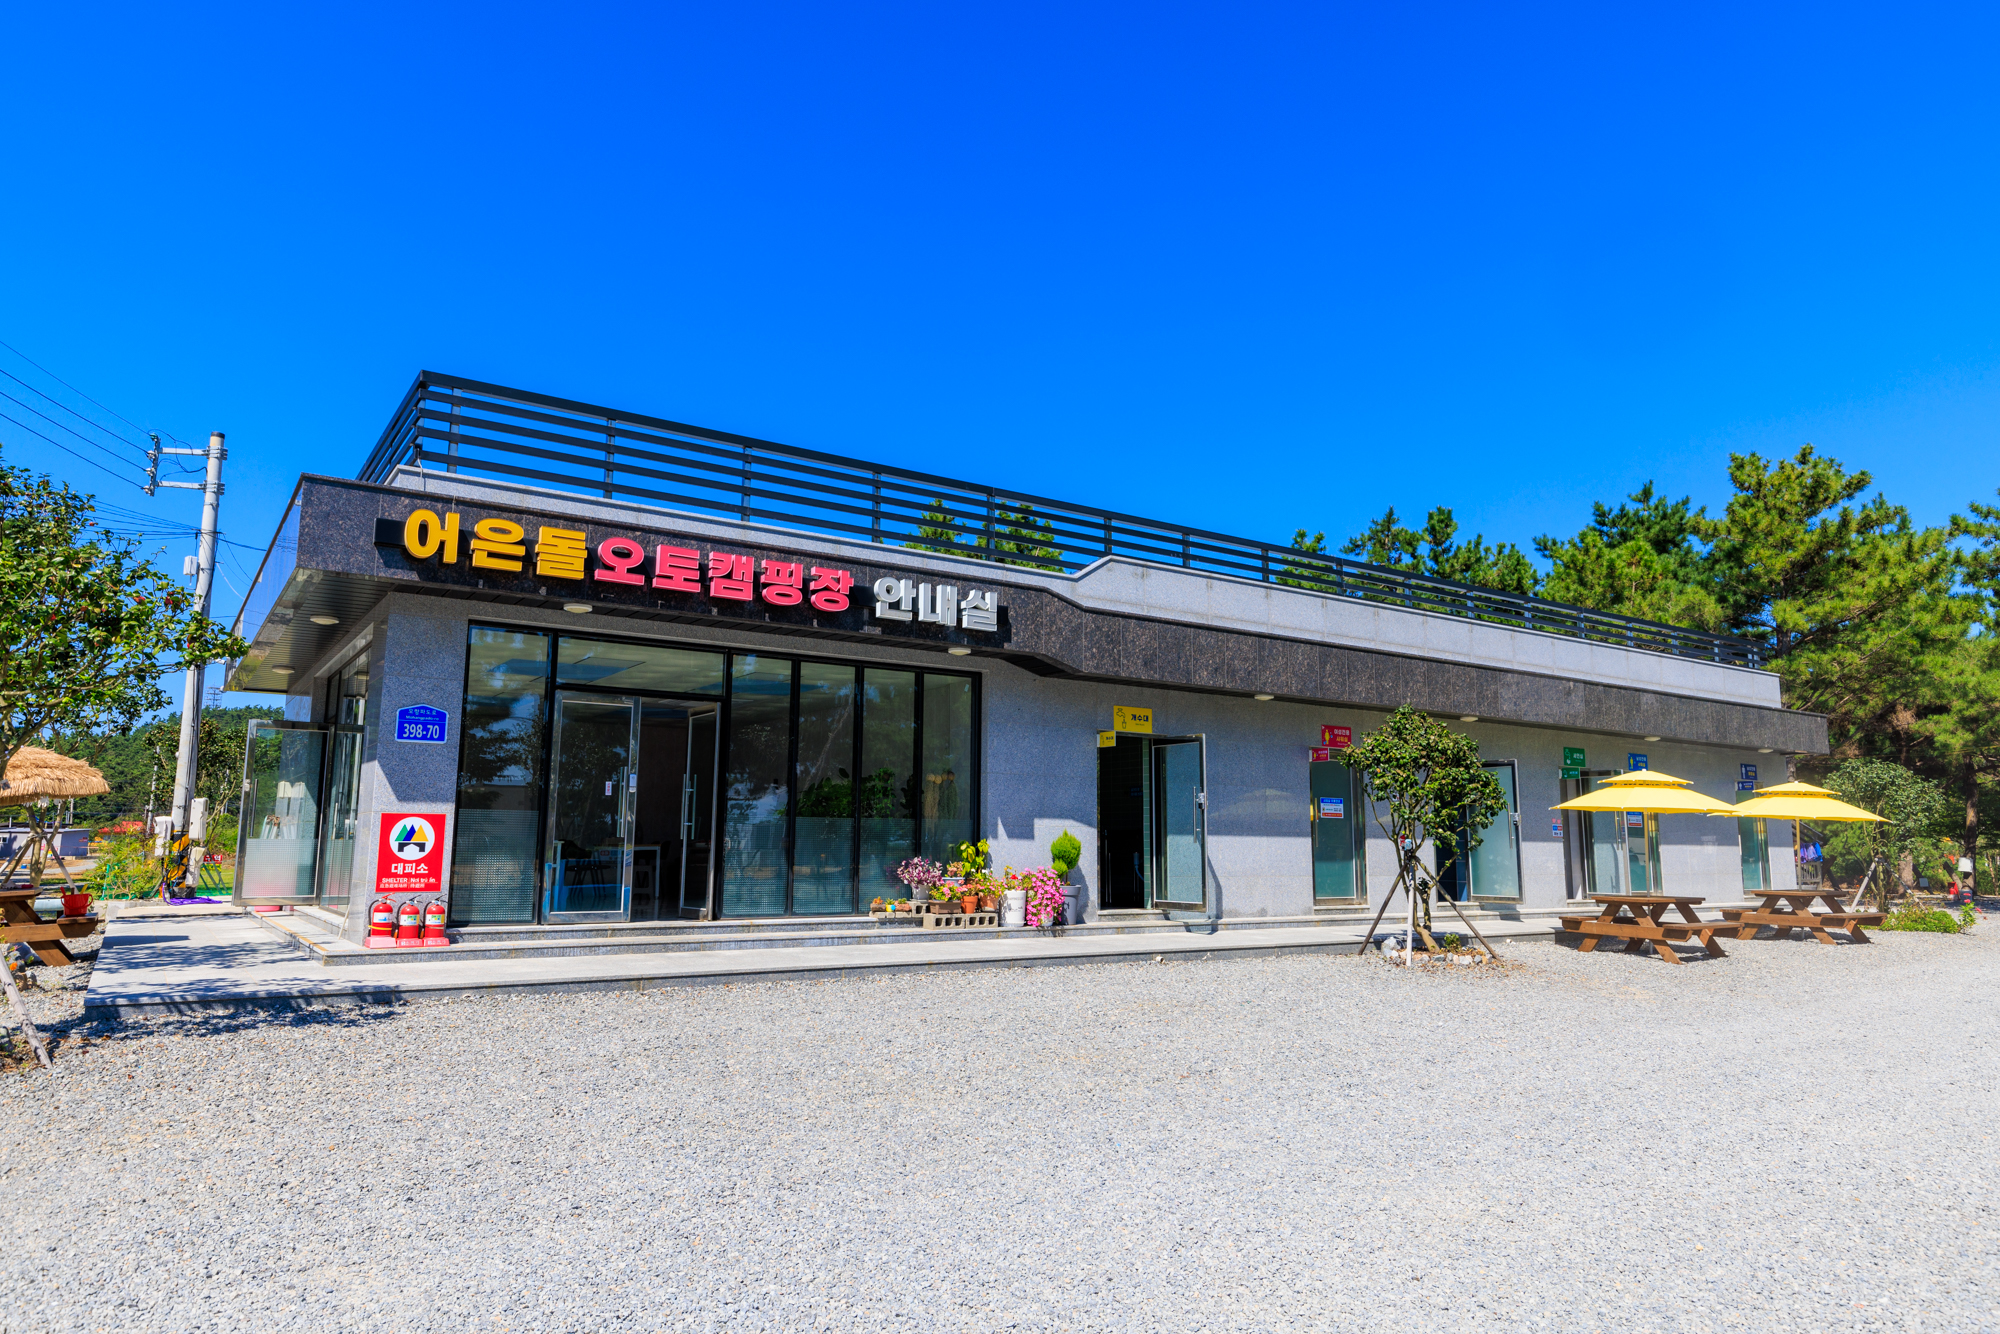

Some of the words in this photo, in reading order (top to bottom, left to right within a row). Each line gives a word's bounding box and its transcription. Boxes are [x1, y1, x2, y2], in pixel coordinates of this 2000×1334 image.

[404, 508, 587, 580] 어은돌
[594, 537, 854, 612] 오토캠핑장
[874, 576, 998, 632] 안내실
[402, 723, 440, 739] 398-70
[391, 862, 429, 875] 대피소
